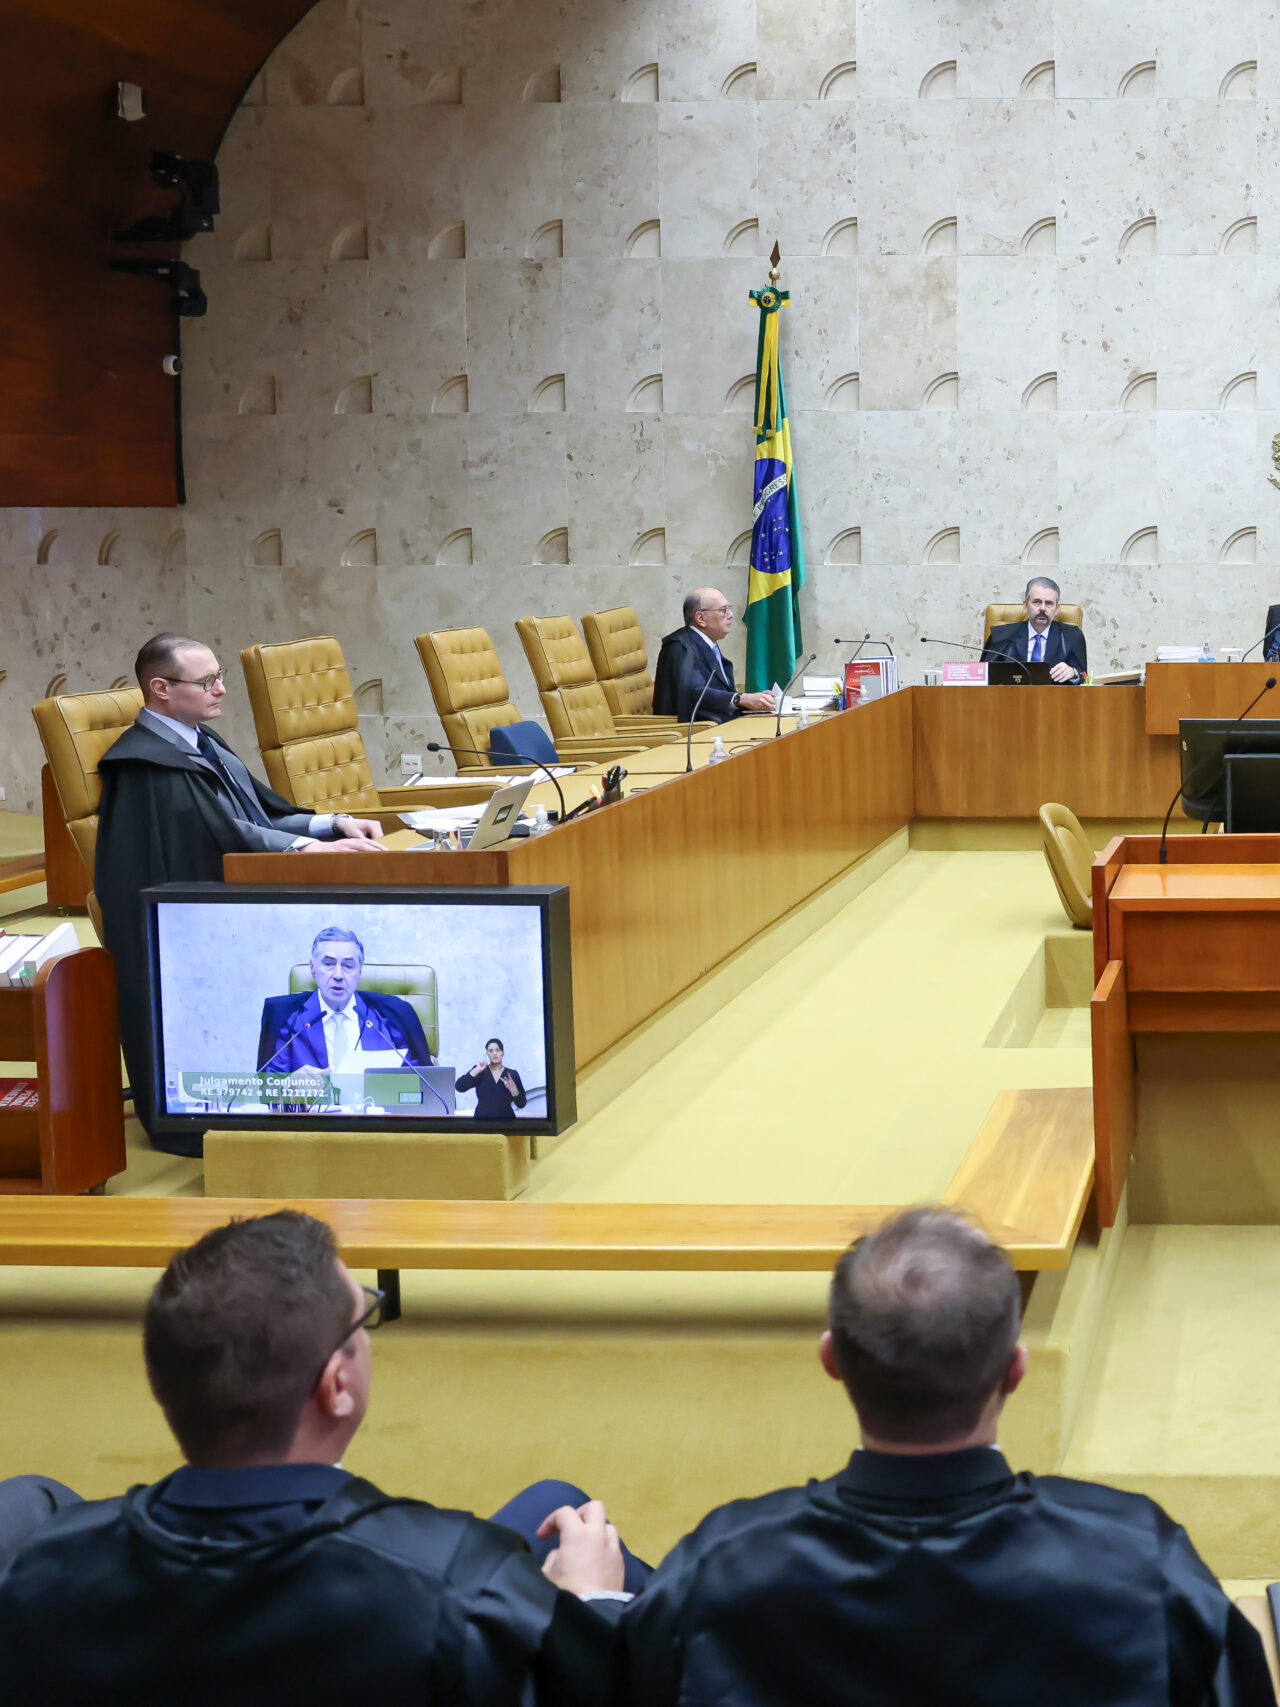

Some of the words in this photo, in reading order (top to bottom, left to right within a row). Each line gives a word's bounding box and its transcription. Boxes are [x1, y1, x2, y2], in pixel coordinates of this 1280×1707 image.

[200, 1076, 263, 1087] Julgamento
[266, 1077, 320, 1087] Conjunto:
[200, 1088, 214, 1096] RE
[216, 1088, 253, 1097] 979742
[256, 1089, 262, 1097] e
[265, 1088, 278, 1097] RE
